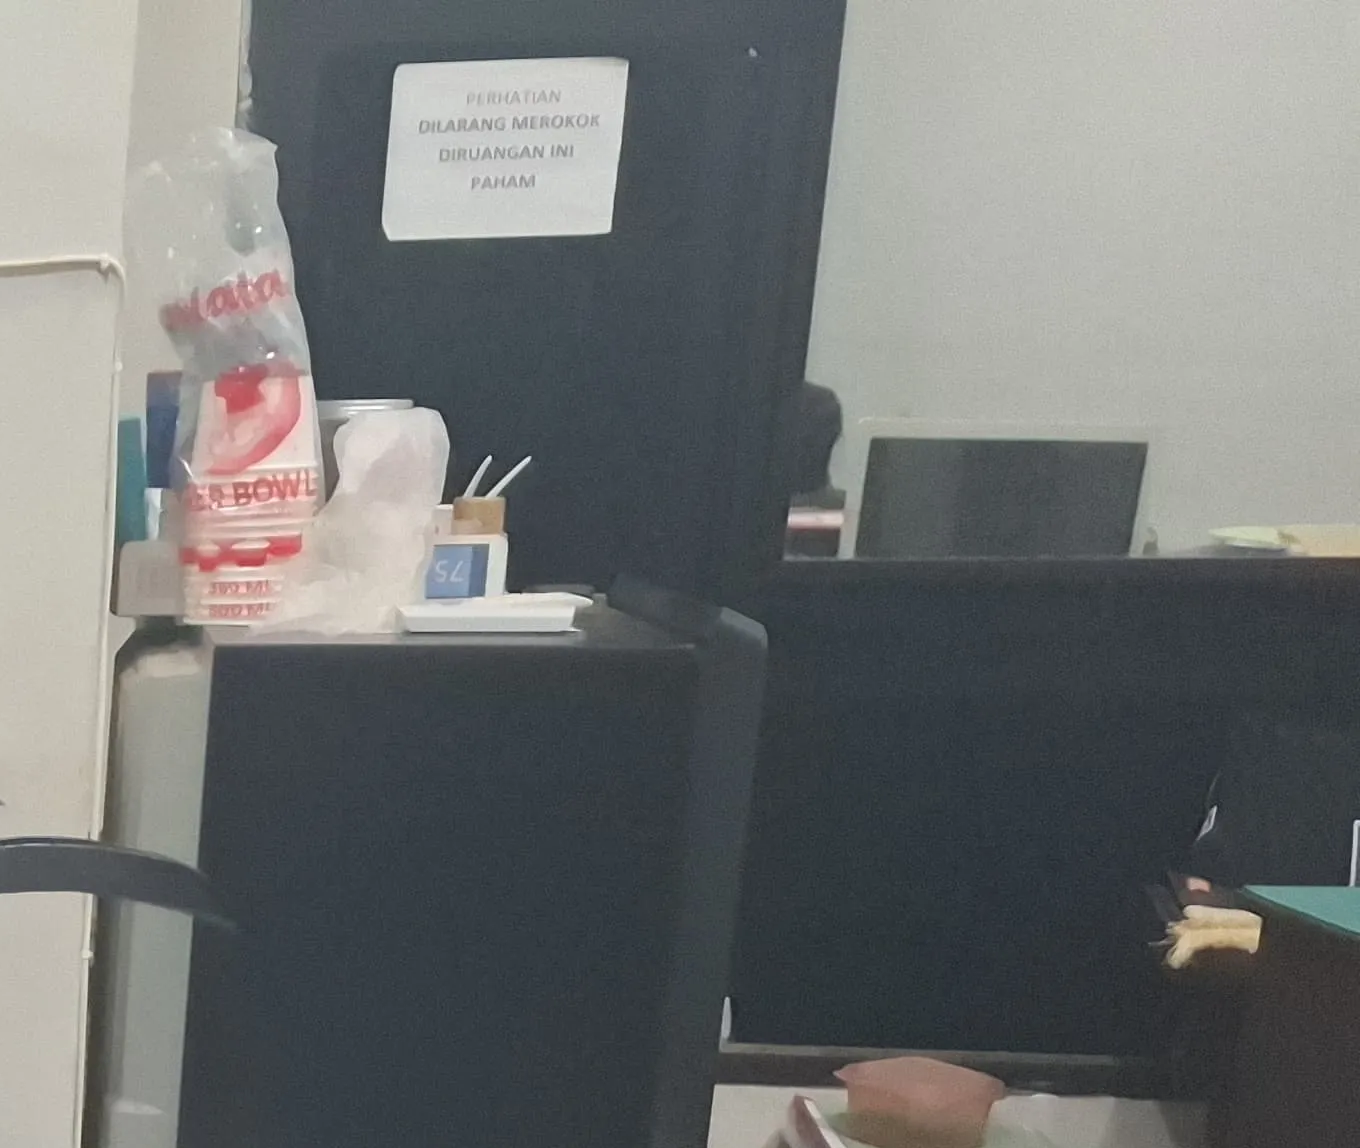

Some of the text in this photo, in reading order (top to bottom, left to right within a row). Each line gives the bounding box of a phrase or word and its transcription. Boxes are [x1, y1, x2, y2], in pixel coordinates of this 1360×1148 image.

[466, 89, 562, 106] PERHATIAN
[418, 113, 601, 134] DILARANG MEROKOK
[438, 144, 575, 163] DIRUANGAN INI
[470, 174, 536, 190] PAHAM
[232, 469, 318, 506] BOWL
